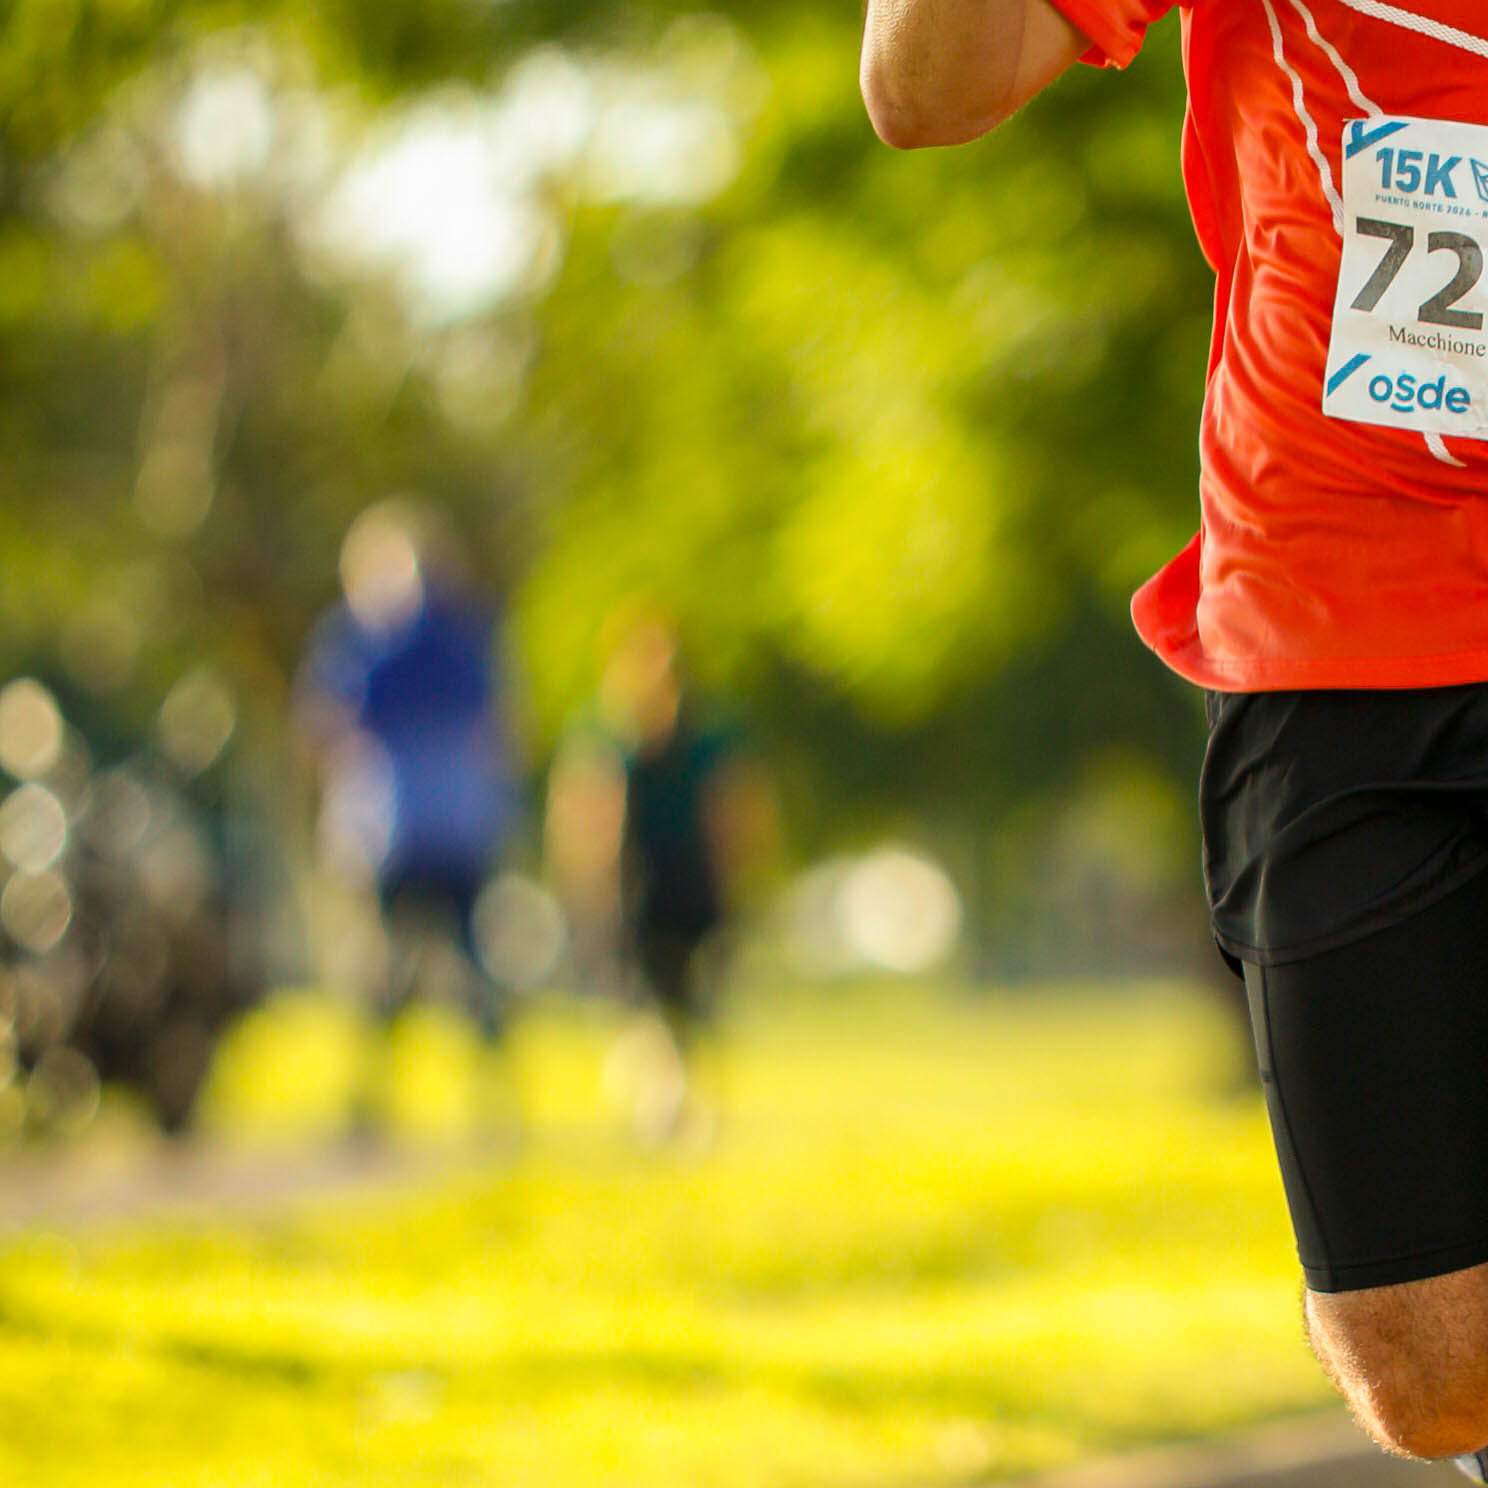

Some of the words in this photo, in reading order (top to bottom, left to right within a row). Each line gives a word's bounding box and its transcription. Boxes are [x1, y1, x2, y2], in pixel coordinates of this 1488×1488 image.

[1375, 147, 1463, 198] 15K
[1375, 194, 1410, 208] PUERTO
[1413, 200, 1444, 211] NORTE
[1447, 205, 1472, 216] 2026
[1388, 324, 1486, 357] Macchione
[1369, 372, 1471, 413] osde
